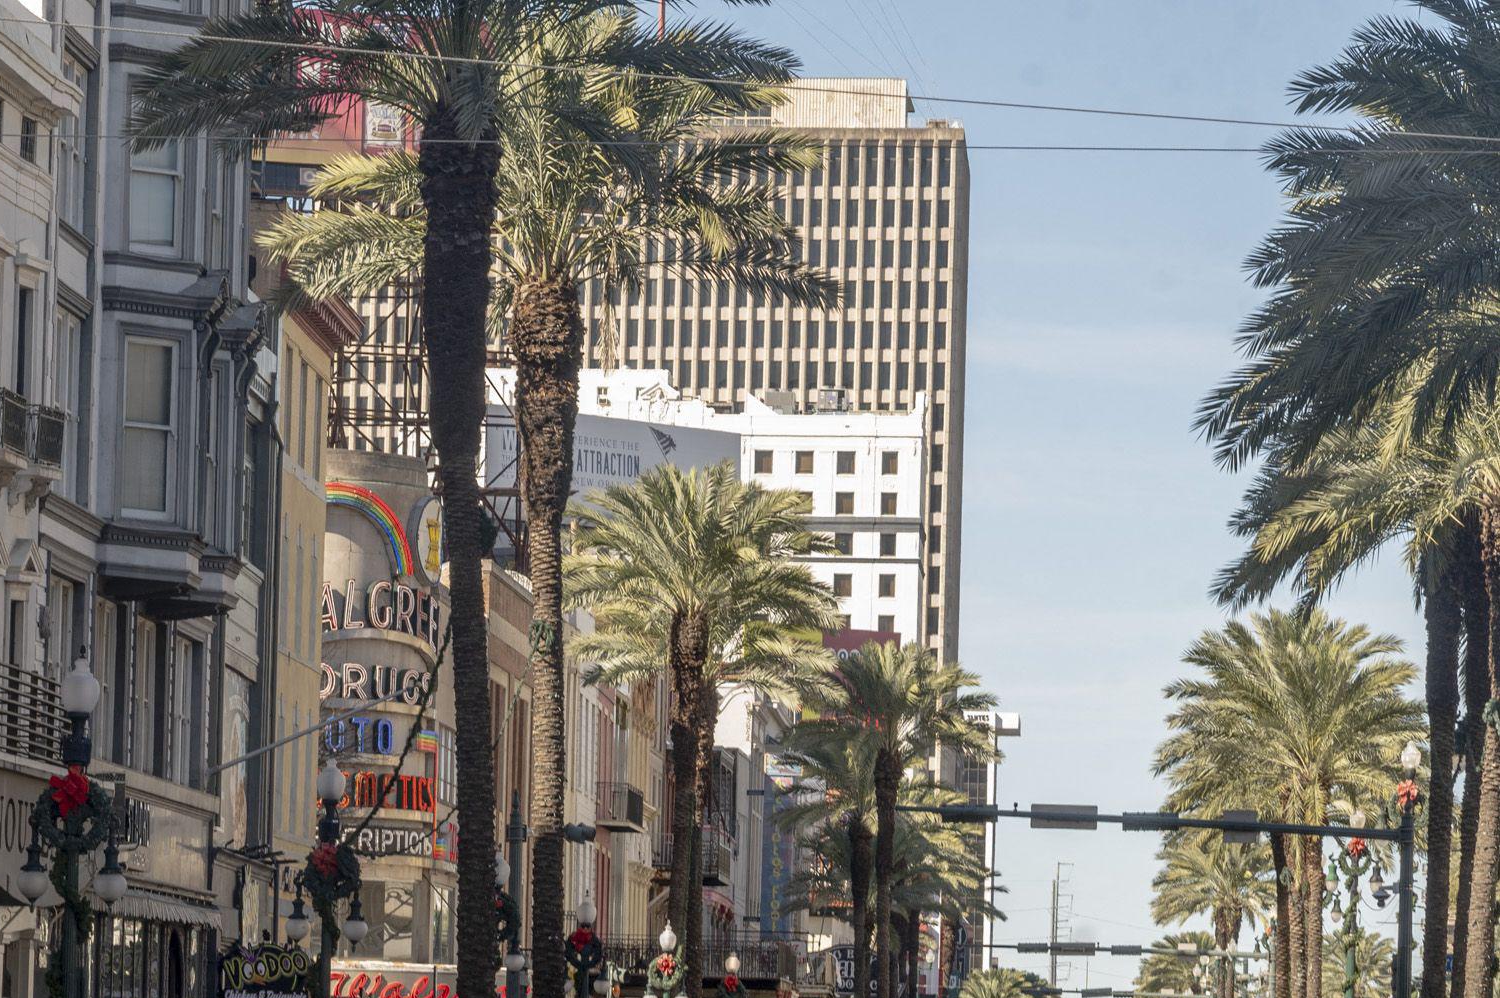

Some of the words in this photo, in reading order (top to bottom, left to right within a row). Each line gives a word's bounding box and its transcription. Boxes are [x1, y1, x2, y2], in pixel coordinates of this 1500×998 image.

[573, 435, 617, 450] PERIENCE
[620, 439, 641, 450] THE
[576, 449, 640, 478] ATTRACTION
[223, 950, 309, 990] VOODOO
